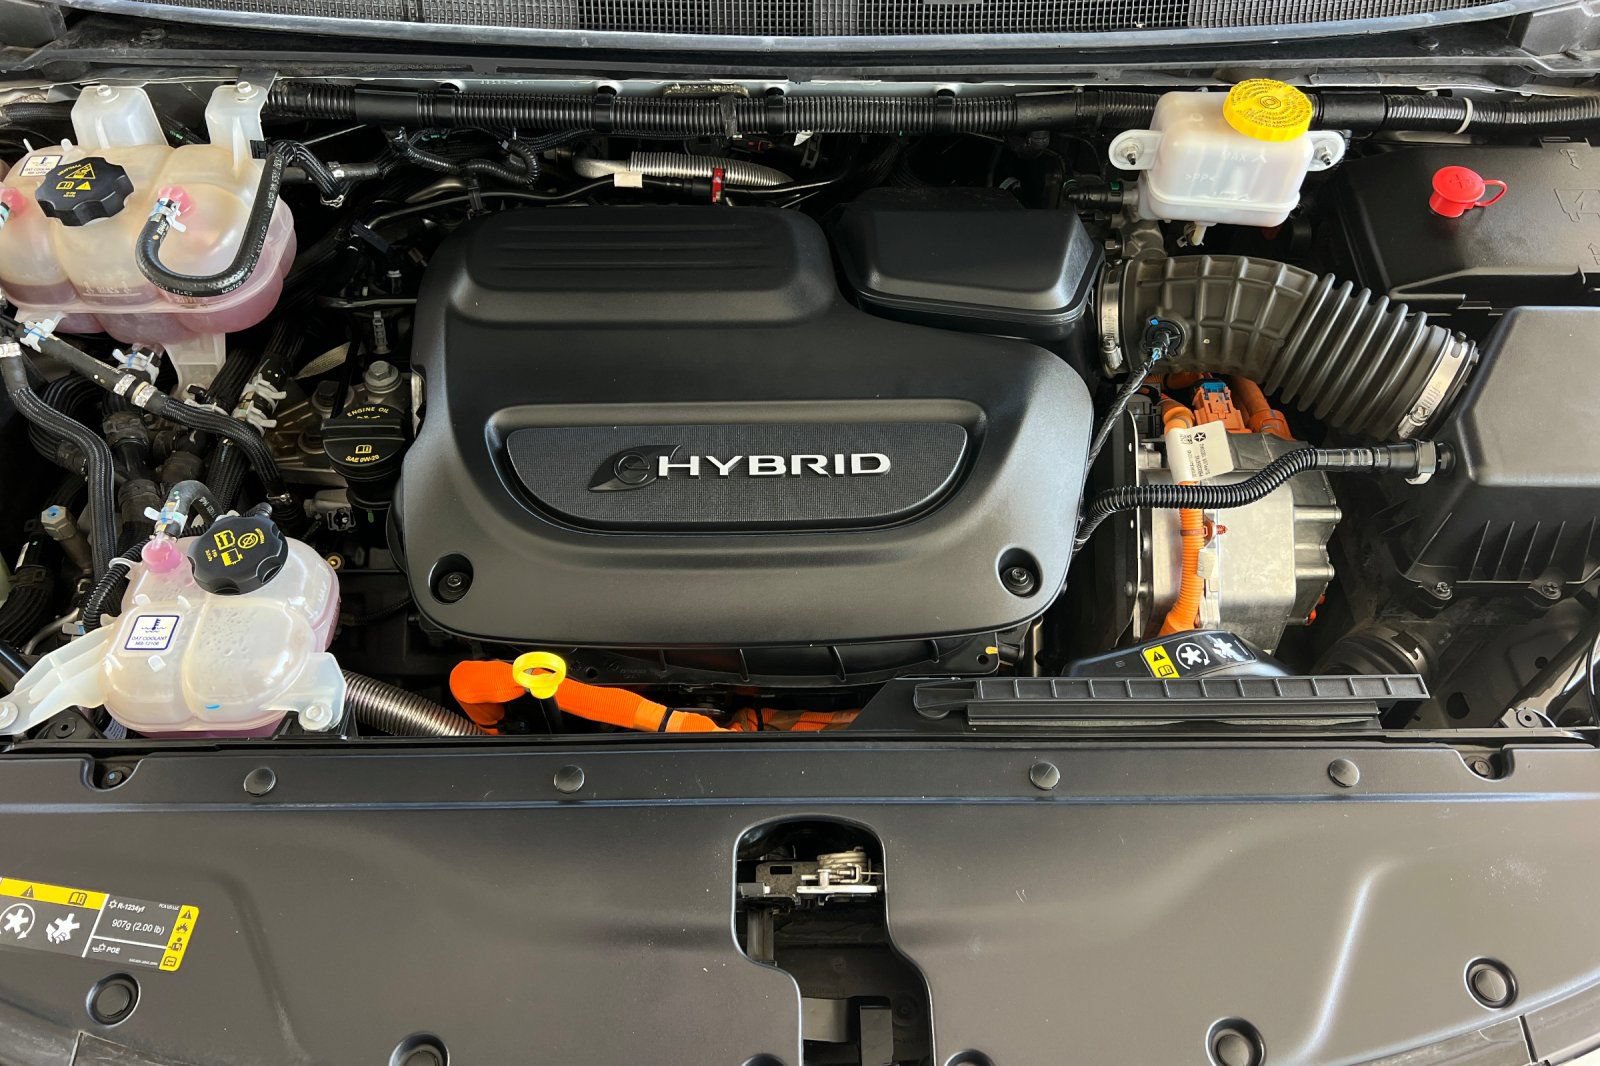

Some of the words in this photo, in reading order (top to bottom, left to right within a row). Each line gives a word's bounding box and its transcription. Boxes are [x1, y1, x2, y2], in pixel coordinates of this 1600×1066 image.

[347, 407, 375, 417] ENGINE
[658, 453, 891, 477] HYBRID
[117, 902, 146, 913] R-1234yf
[111, 918, 132, 931] 907g
[132, 922, 153, 932] (2.00
[153, 925, 165, 936] lb)
[106, 946, 120, 954] POE
